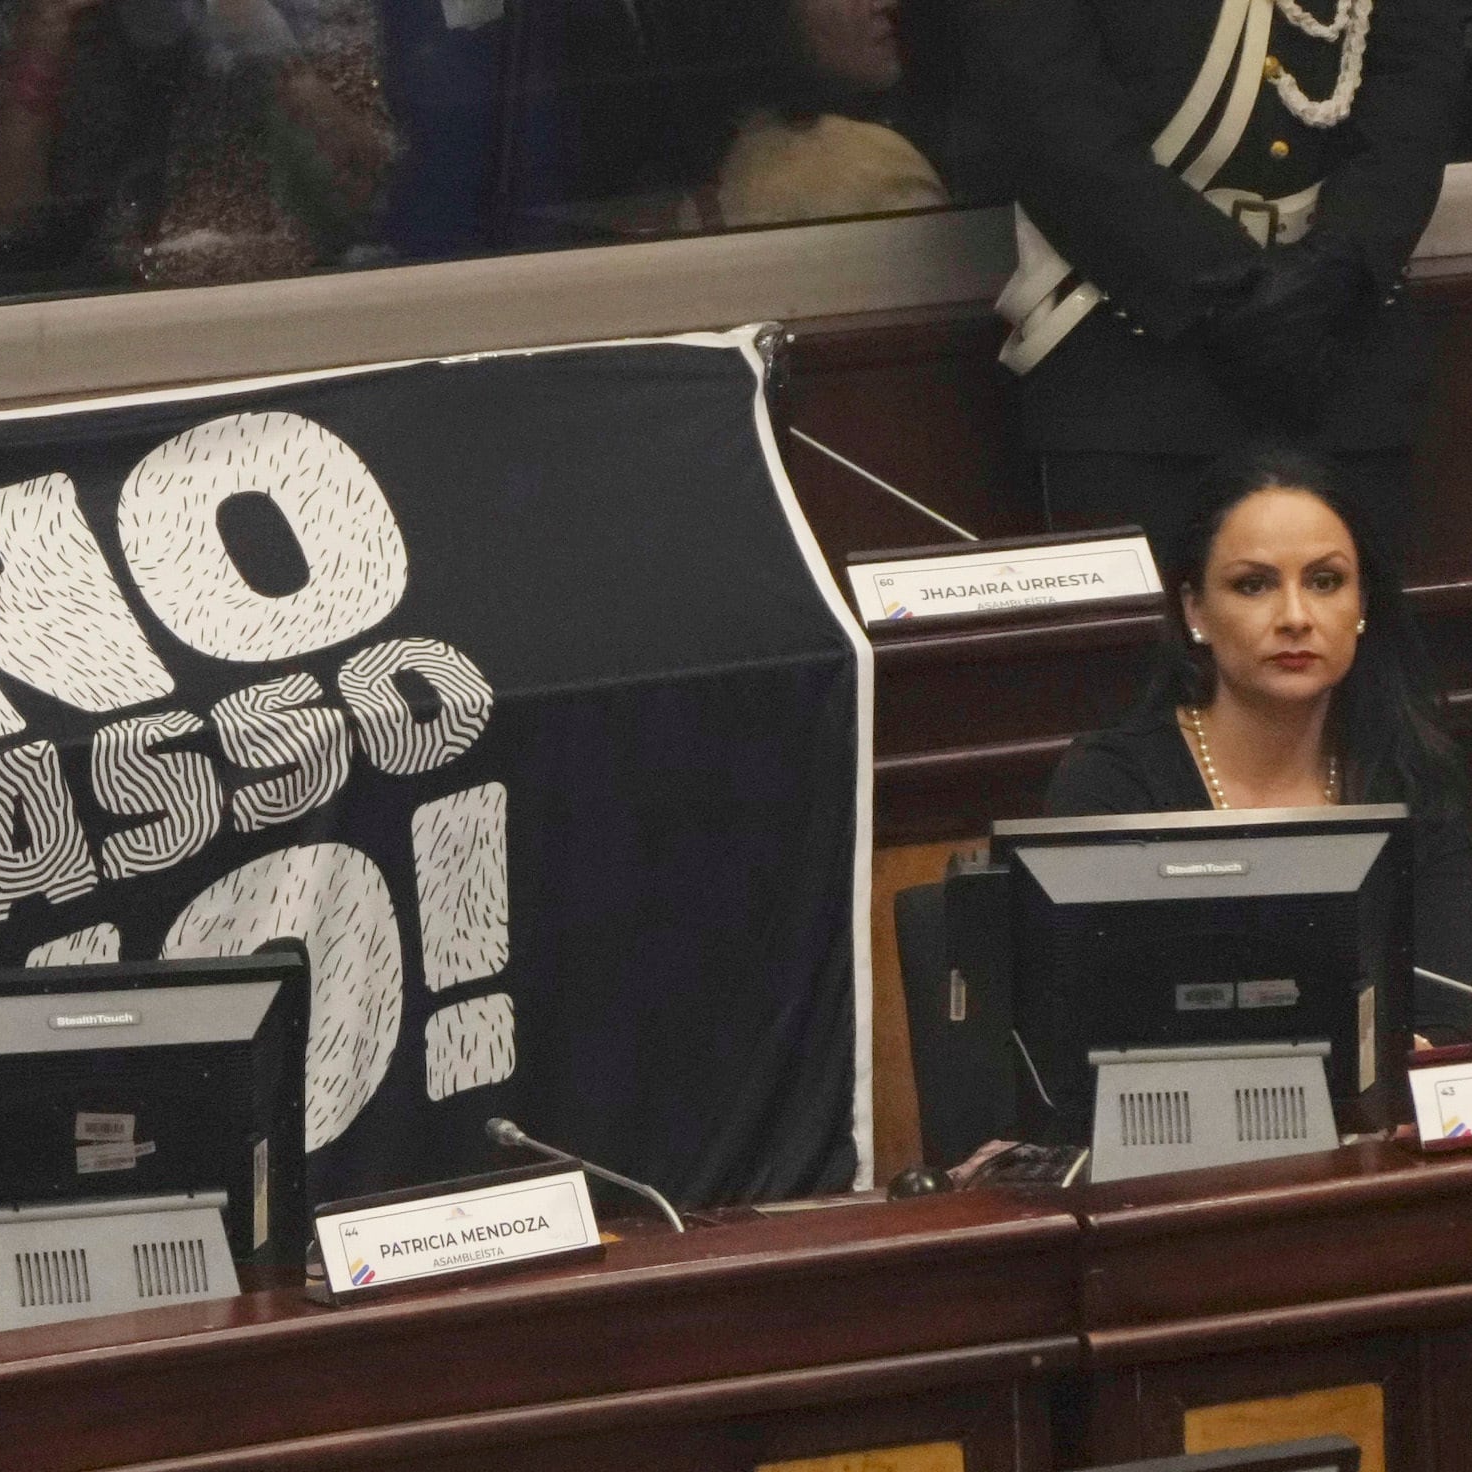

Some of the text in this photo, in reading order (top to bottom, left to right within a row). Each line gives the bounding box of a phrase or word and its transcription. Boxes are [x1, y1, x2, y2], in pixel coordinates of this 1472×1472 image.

[879, 578, 894, 587] 60
[919, 572, 1104, 600] JHAJAIRA URRESTA
[1166, 864, 1242, 875] StealthTouch
[56, 1013, 133, 1027] StealthTouch
[344, 1227, 359, 1237] 44
[379, 1215, 550, 1258] PATRICIA MENDOZA
